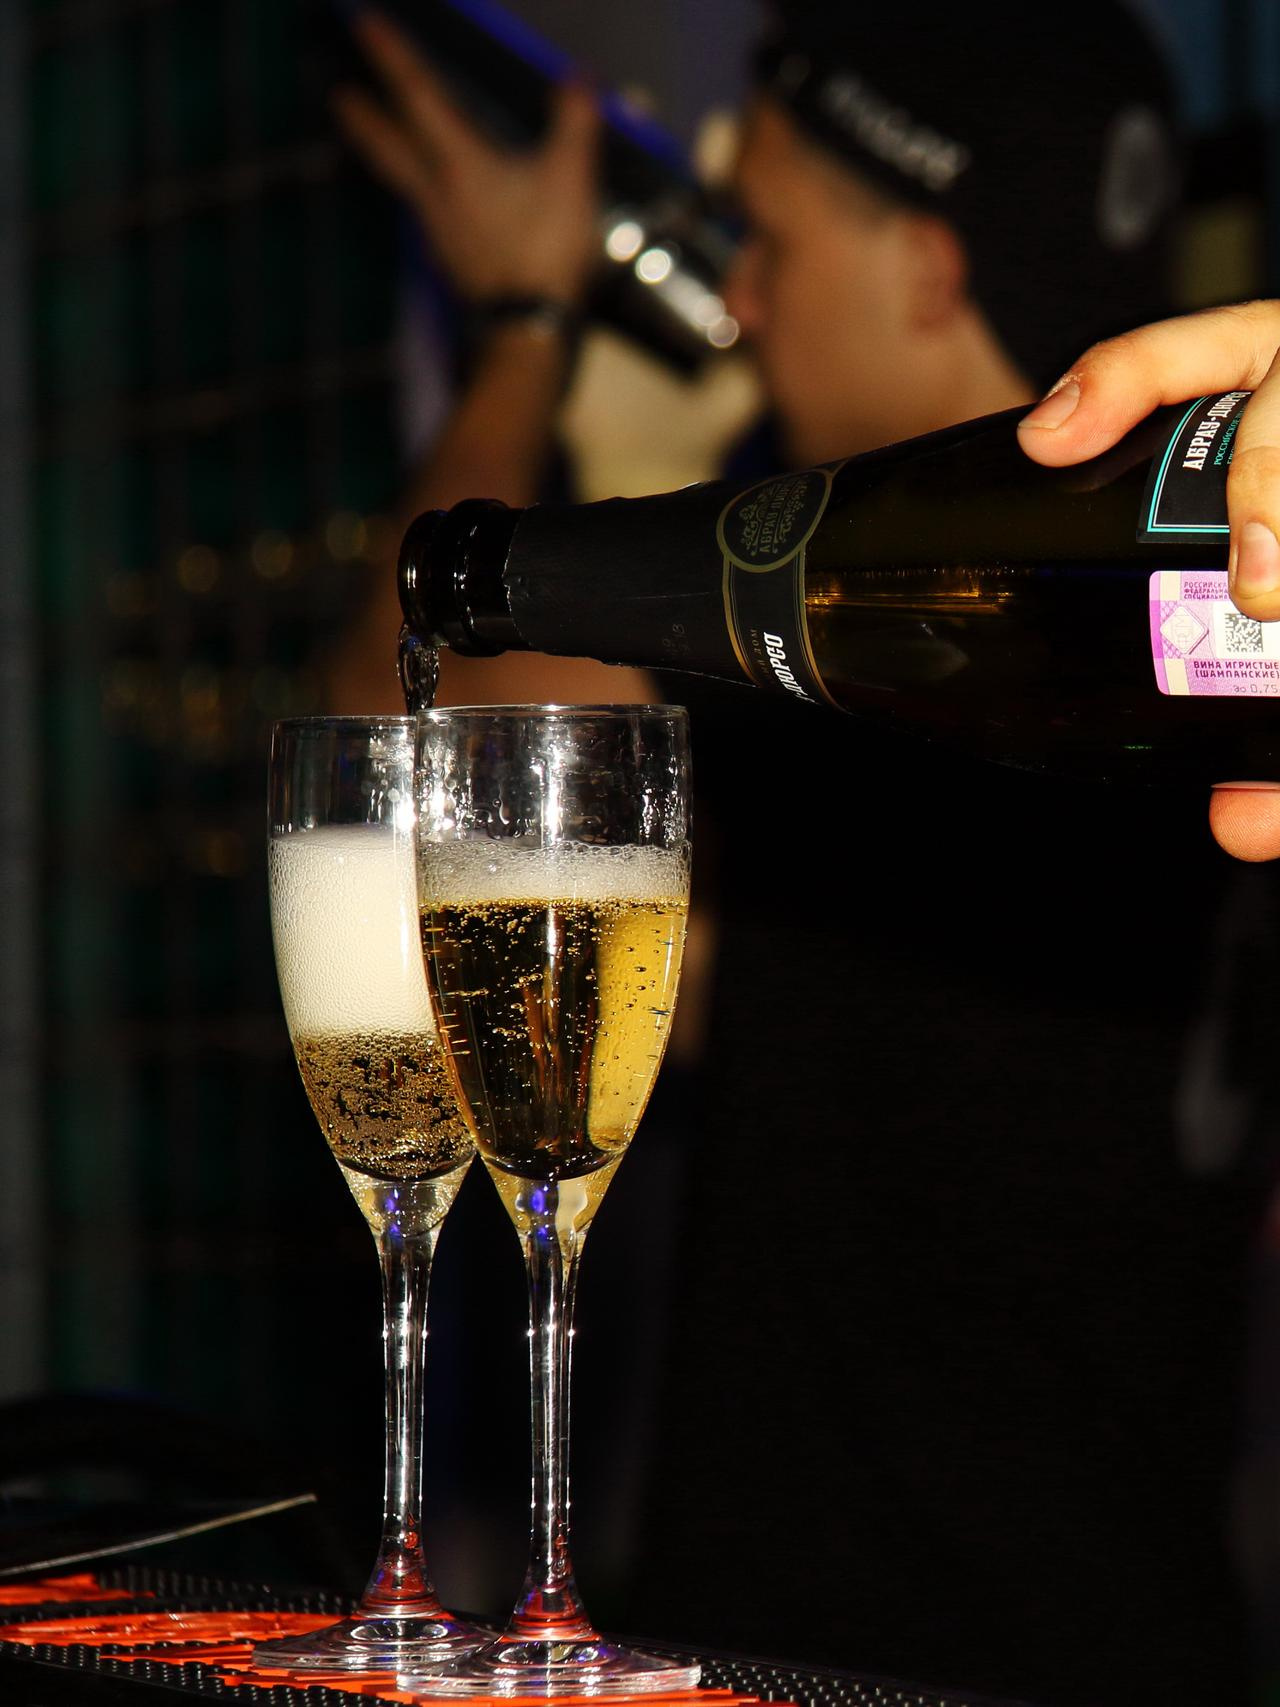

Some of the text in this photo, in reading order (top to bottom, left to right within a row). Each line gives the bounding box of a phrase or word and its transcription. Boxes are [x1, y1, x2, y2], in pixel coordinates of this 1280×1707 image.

[1183, 581, 1228, 589] РОССИЙСКА
[1193, 660, 1280, 670] ВИНА ИГРИСТЫЕ
[1195, 670, 1280, 679] (ШАМПАНСКИЕ)
